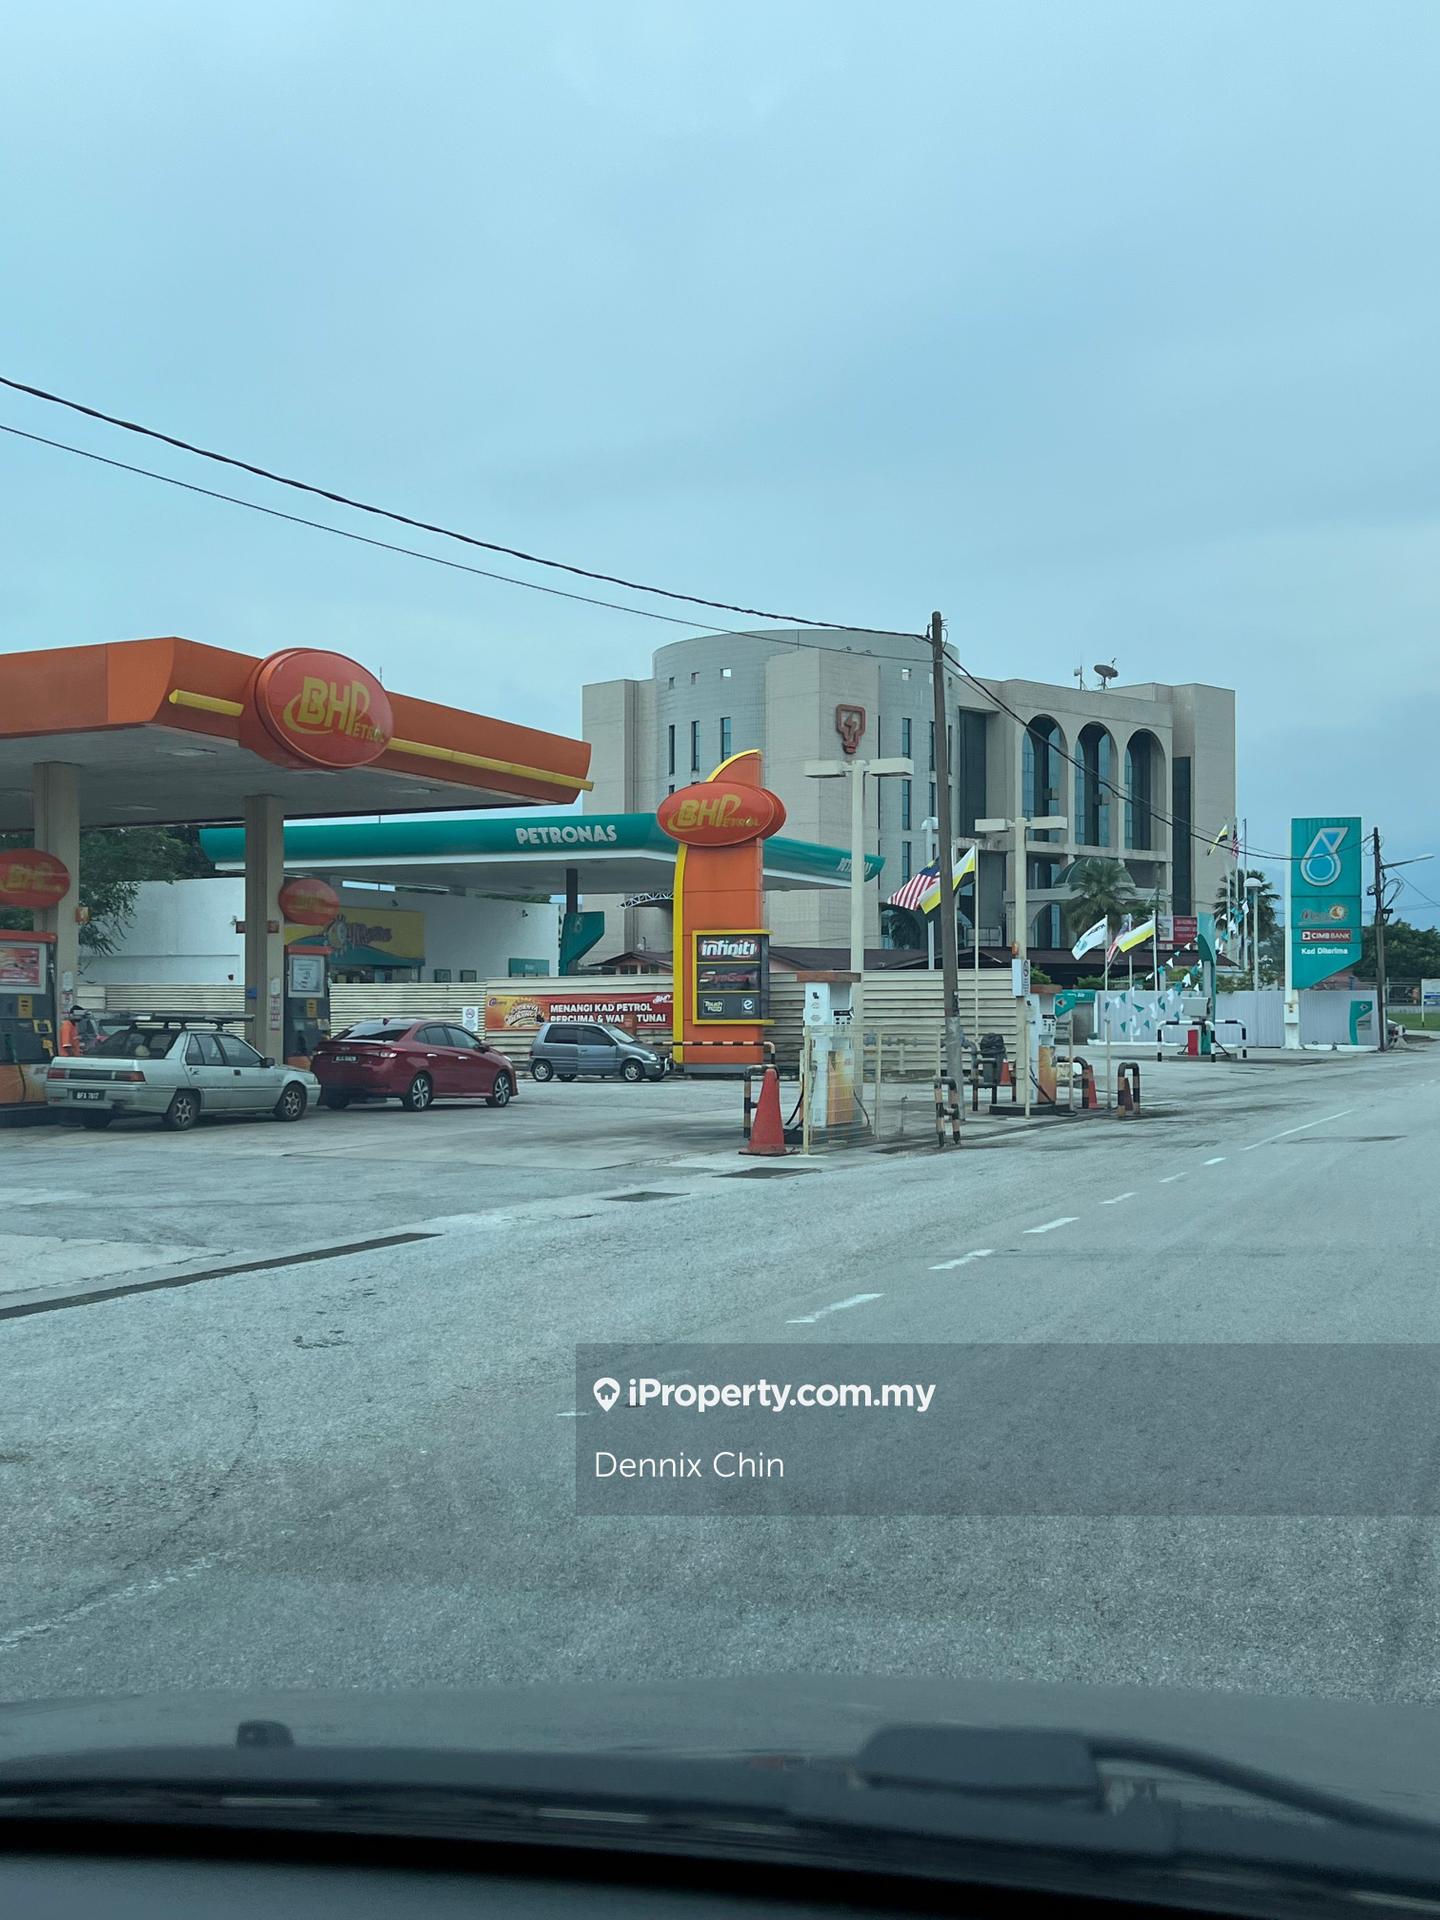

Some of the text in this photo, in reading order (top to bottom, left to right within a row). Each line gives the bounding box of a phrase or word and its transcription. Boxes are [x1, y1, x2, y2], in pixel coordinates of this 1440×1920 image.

[515, 825, 618, 844] PETRONAS
[701, 940, 756, 956] infiniti
[550, 1003, 594, 1013] MENANGI
[594, 1003, 615, 1013] KAD
[616, 1002, 653, 1012] PETROL
[637, 1013, 666, 1023] TUNAI
